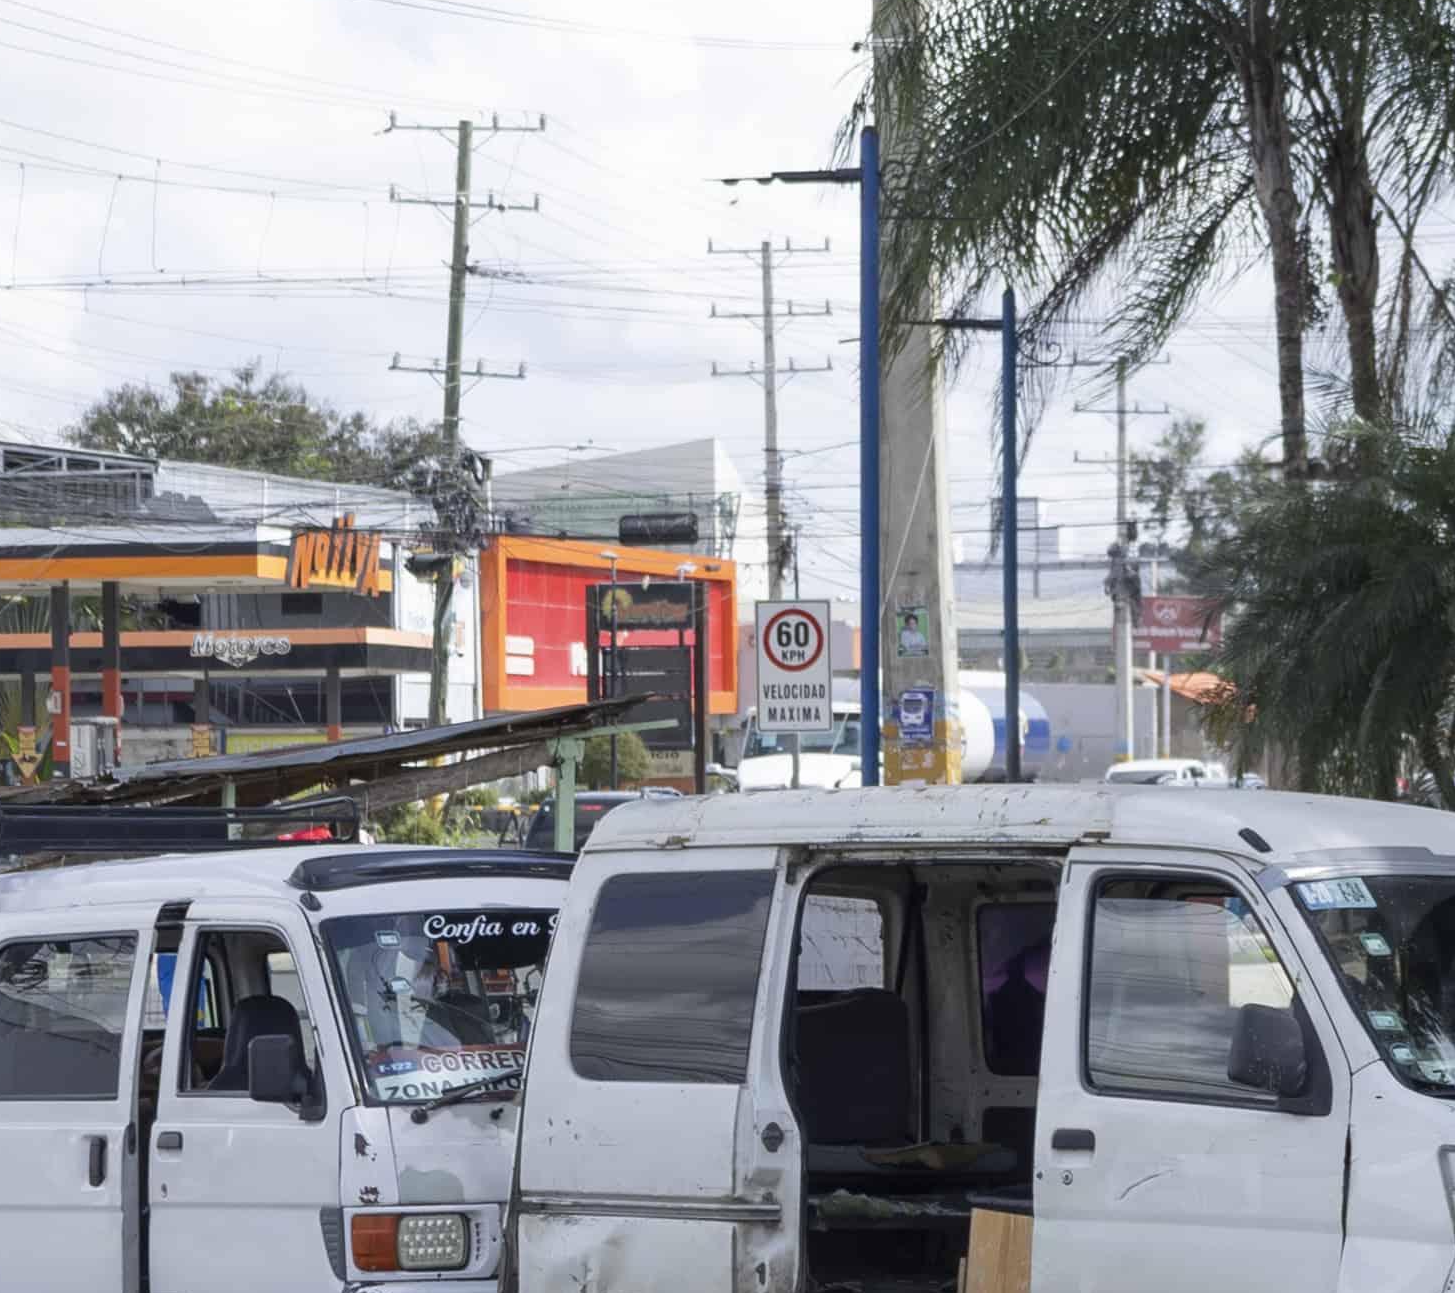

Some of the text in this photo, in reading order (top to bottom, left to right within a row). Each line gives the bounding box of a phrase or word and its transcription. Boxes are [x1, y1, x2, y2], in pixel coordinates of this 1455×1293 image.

[777, 621, 810, 648] 60
[781, 649, 806, 661] KPH
[763, 684, 826, 699] VELOCIDAD
[768, 707, 821, 722] MAXIMA
[512, 920, 541, 936] en
